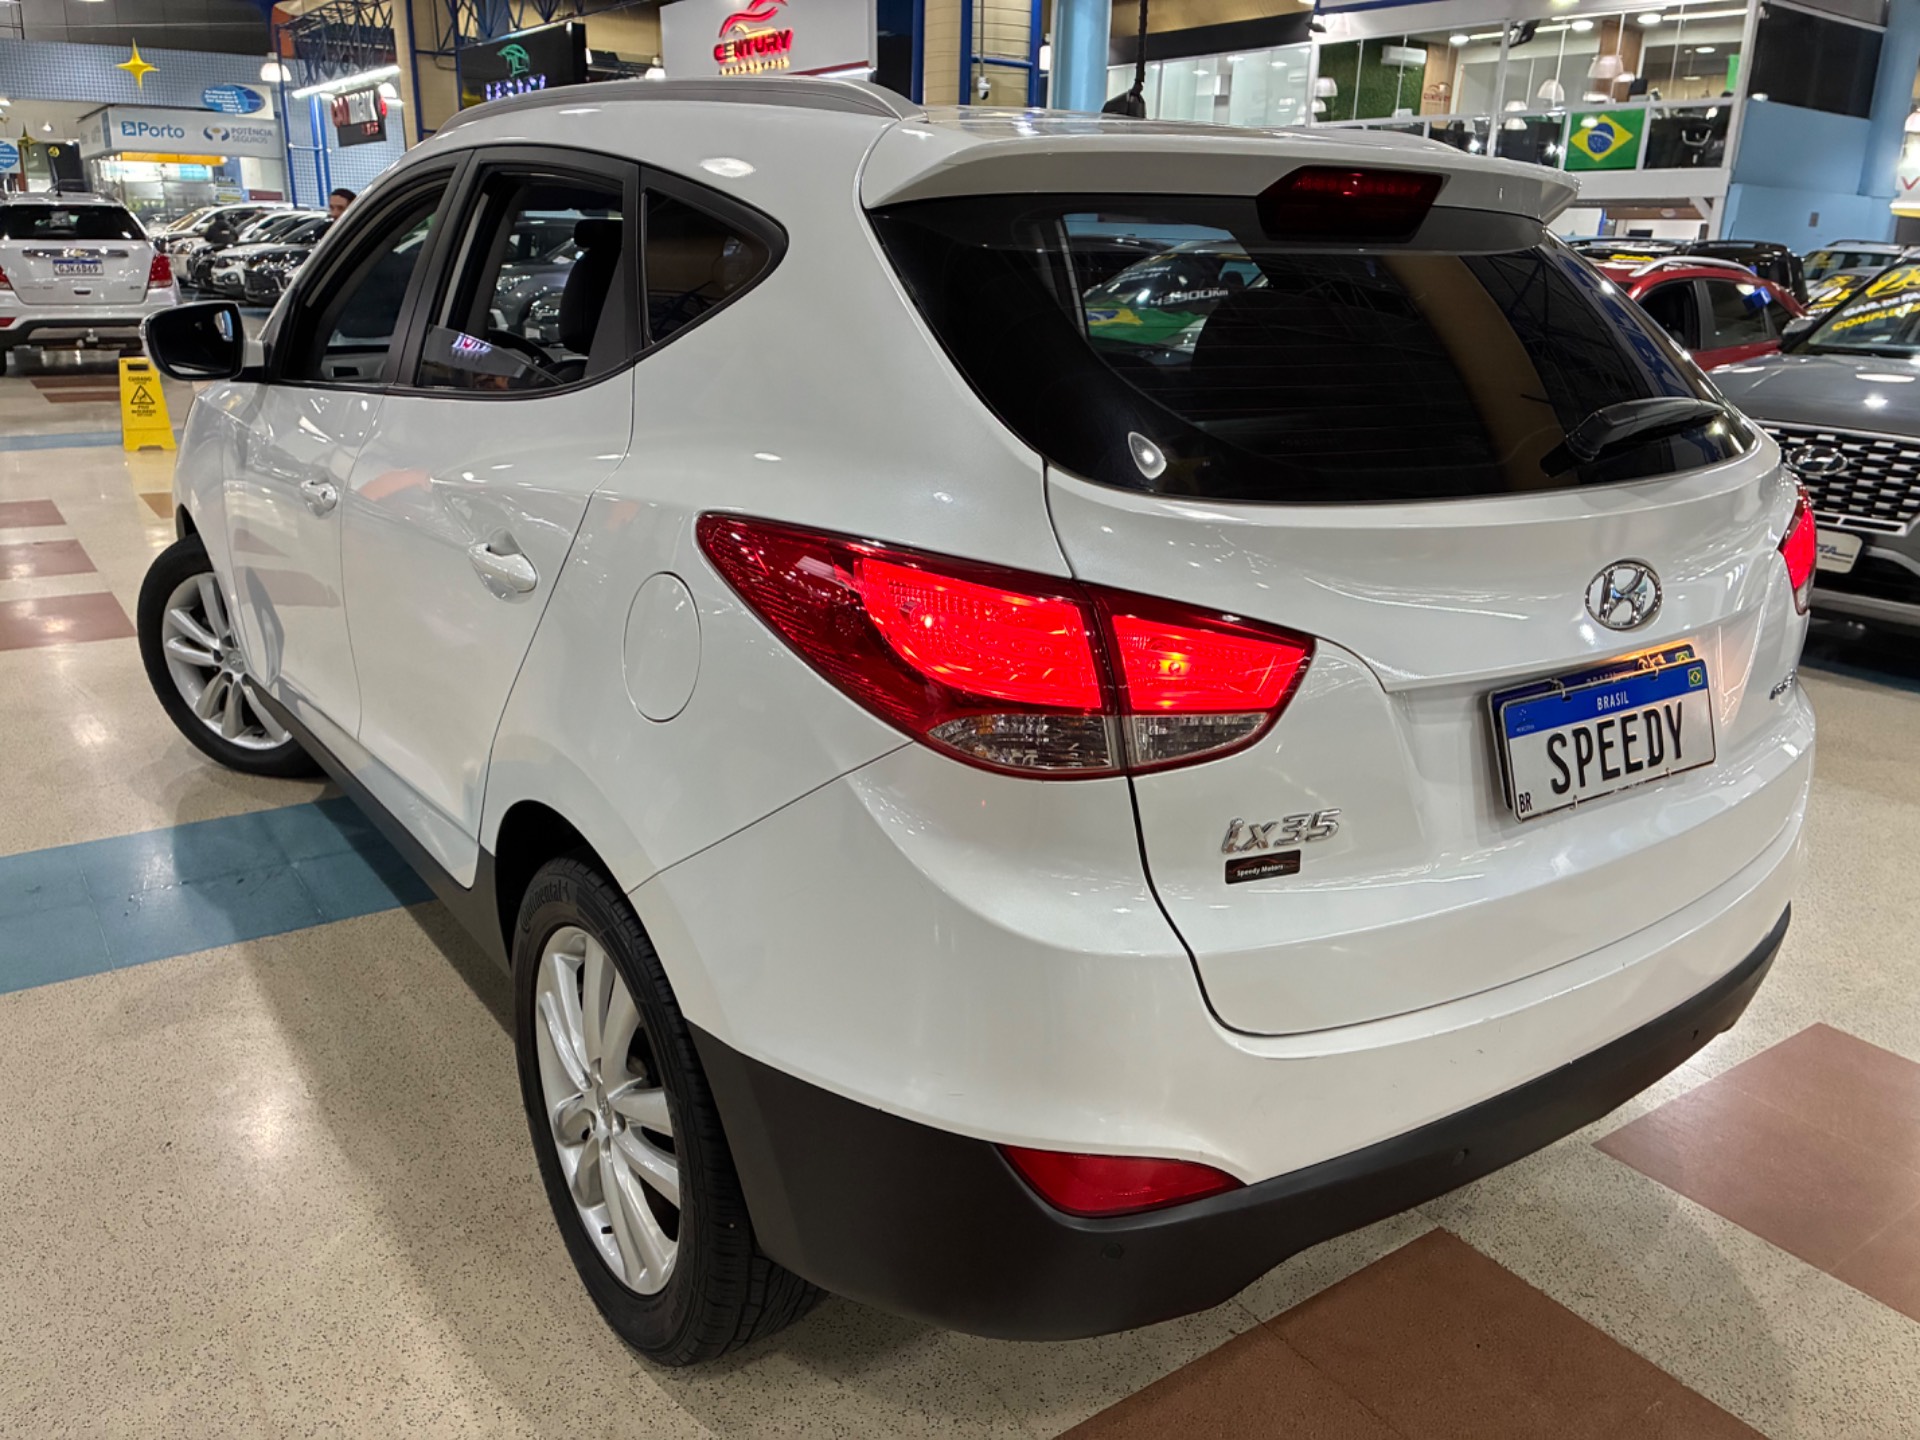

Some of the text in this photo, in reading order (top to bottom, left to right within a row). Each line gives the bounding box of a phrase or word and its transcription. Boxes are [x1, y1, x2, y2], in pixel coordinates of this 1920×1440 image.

[713, 28, 793, 64] CENTURY
[138, 121, 185, 138] Porto
[1597, 690, 1630, 711] BRASIL
[1547, 700, 1683, 795] SPEEDY
[1518, 792, 1533, 814] BR
[1221, 808, 1342, 854] ix35
[1236, 864, 1284, 877] Speedy Motors
